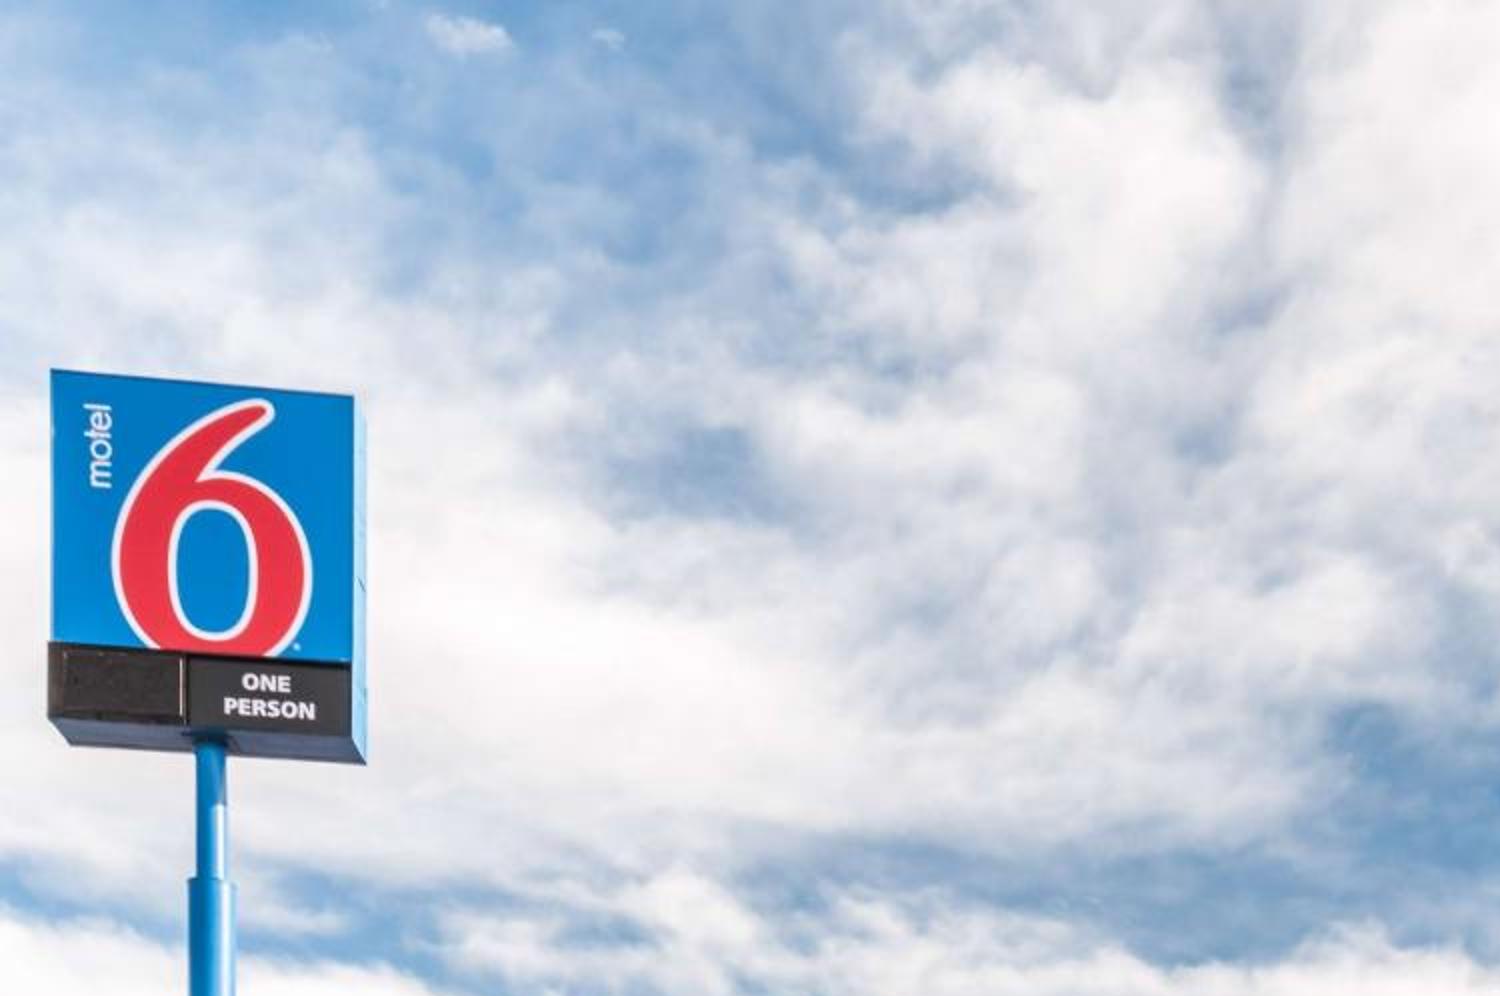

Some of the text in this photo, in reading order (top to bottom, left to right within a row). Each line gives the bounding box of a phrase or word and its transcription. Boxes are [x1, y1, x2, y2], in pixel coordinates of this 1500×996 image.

[83, 403, 112, 489] motel
[111, 398, 313, 658] 6
[223, 696, 316, 720] PERSON
[242, 672, 292, 693] ONE
